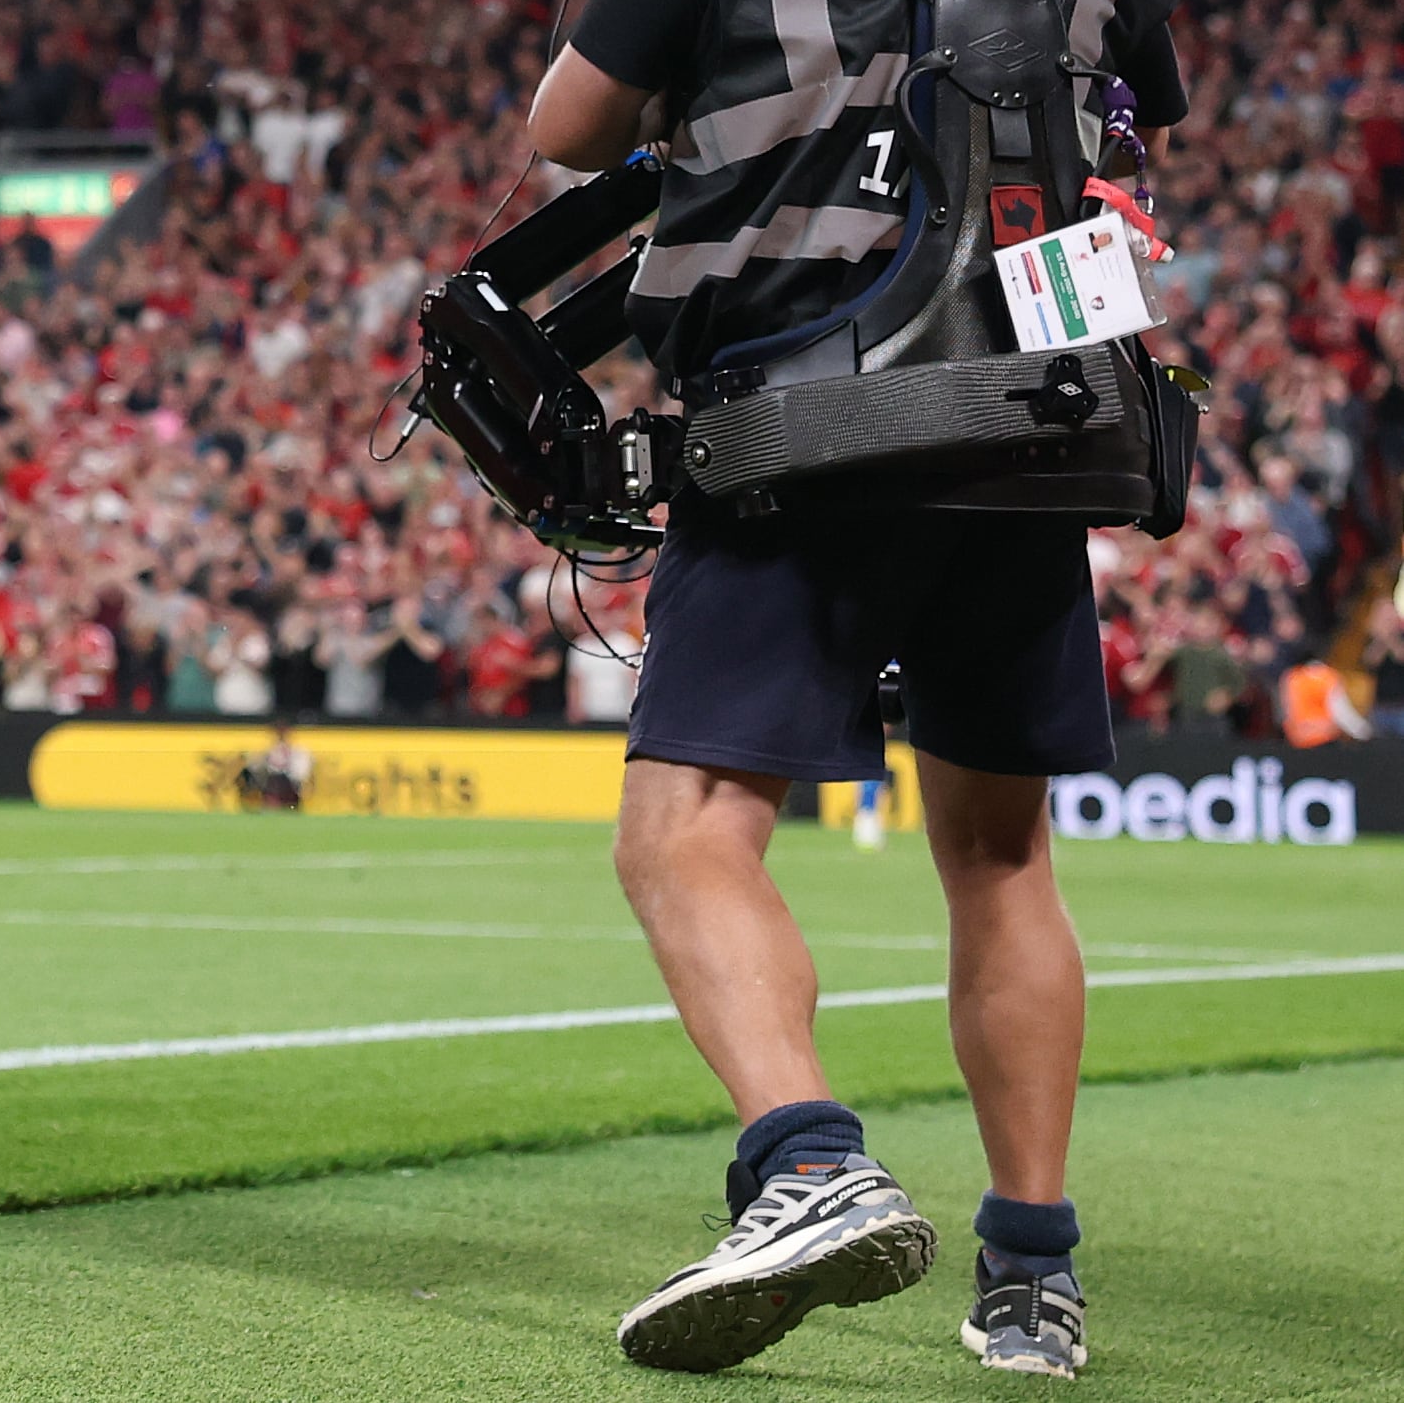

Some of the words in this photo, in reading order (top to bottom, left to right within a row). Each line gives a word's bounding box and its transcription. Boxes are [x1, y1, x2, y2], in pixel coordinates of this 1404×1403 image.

[859, 129, 898, 198] 1
[1052, 755, 1357, 845] pedia
[817, 1178, 878, 1218] SALOMON
